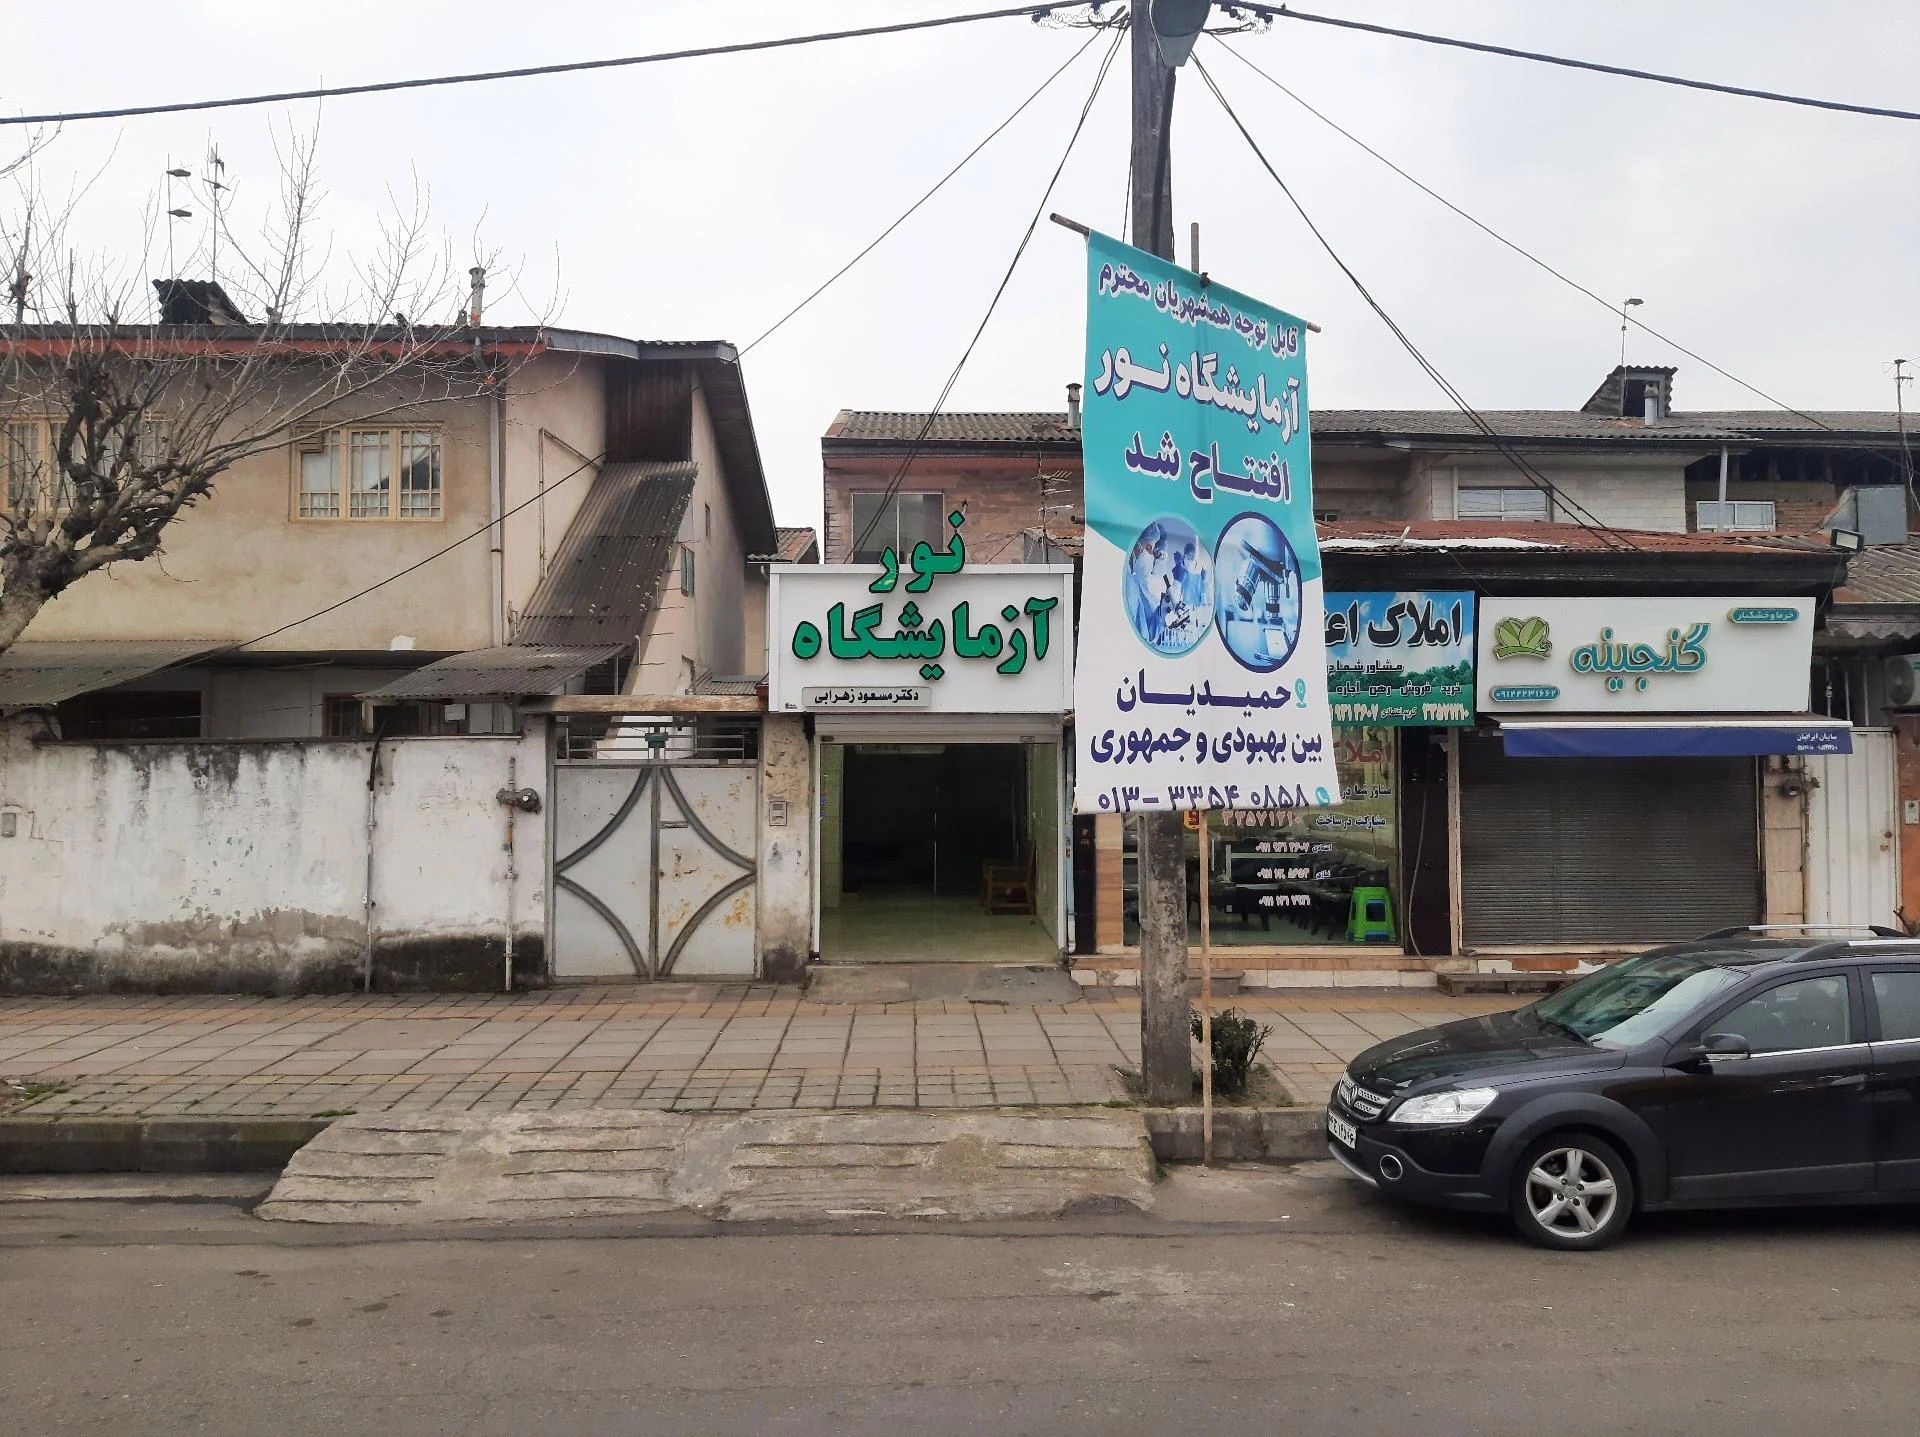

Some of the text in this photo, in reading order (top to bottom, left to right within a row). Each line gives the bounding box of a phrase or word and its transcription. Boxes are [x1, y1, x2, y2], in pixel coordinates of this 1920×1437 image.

[1099, 263, 1299, 360] قابل توجه همشهریان محترم
[1092, 341, 1301, 446] آزمایشگاه نور
[1125, 431, 1292, 505] افتتاح شد
[867, 509, 967, 594] نور
[791, 596, 1060, 682] آزمایشگاه
[1366, 598, 1463, 646] املاک
[1336, 659, 1365, 673] شما
[1365, 659, 1404, 674] مشاور
[1569, 622, 1711, 692] گنجینه
[814, 688, 919, 705] دکتر مسعود زهرابی
[1116, 667, 1292, 718] حمیدیان
[1336, 680, 1462, 698] خرید فروش رهن اجاره
[1090, 726, 1323, 765] بین بهبودی و جمهوری
[1353, 782, 1368, 795] شما
[1369, 785, 1393, 799] مشاور
[1314, 813, 1387, 830] مشارکت در ساخت
